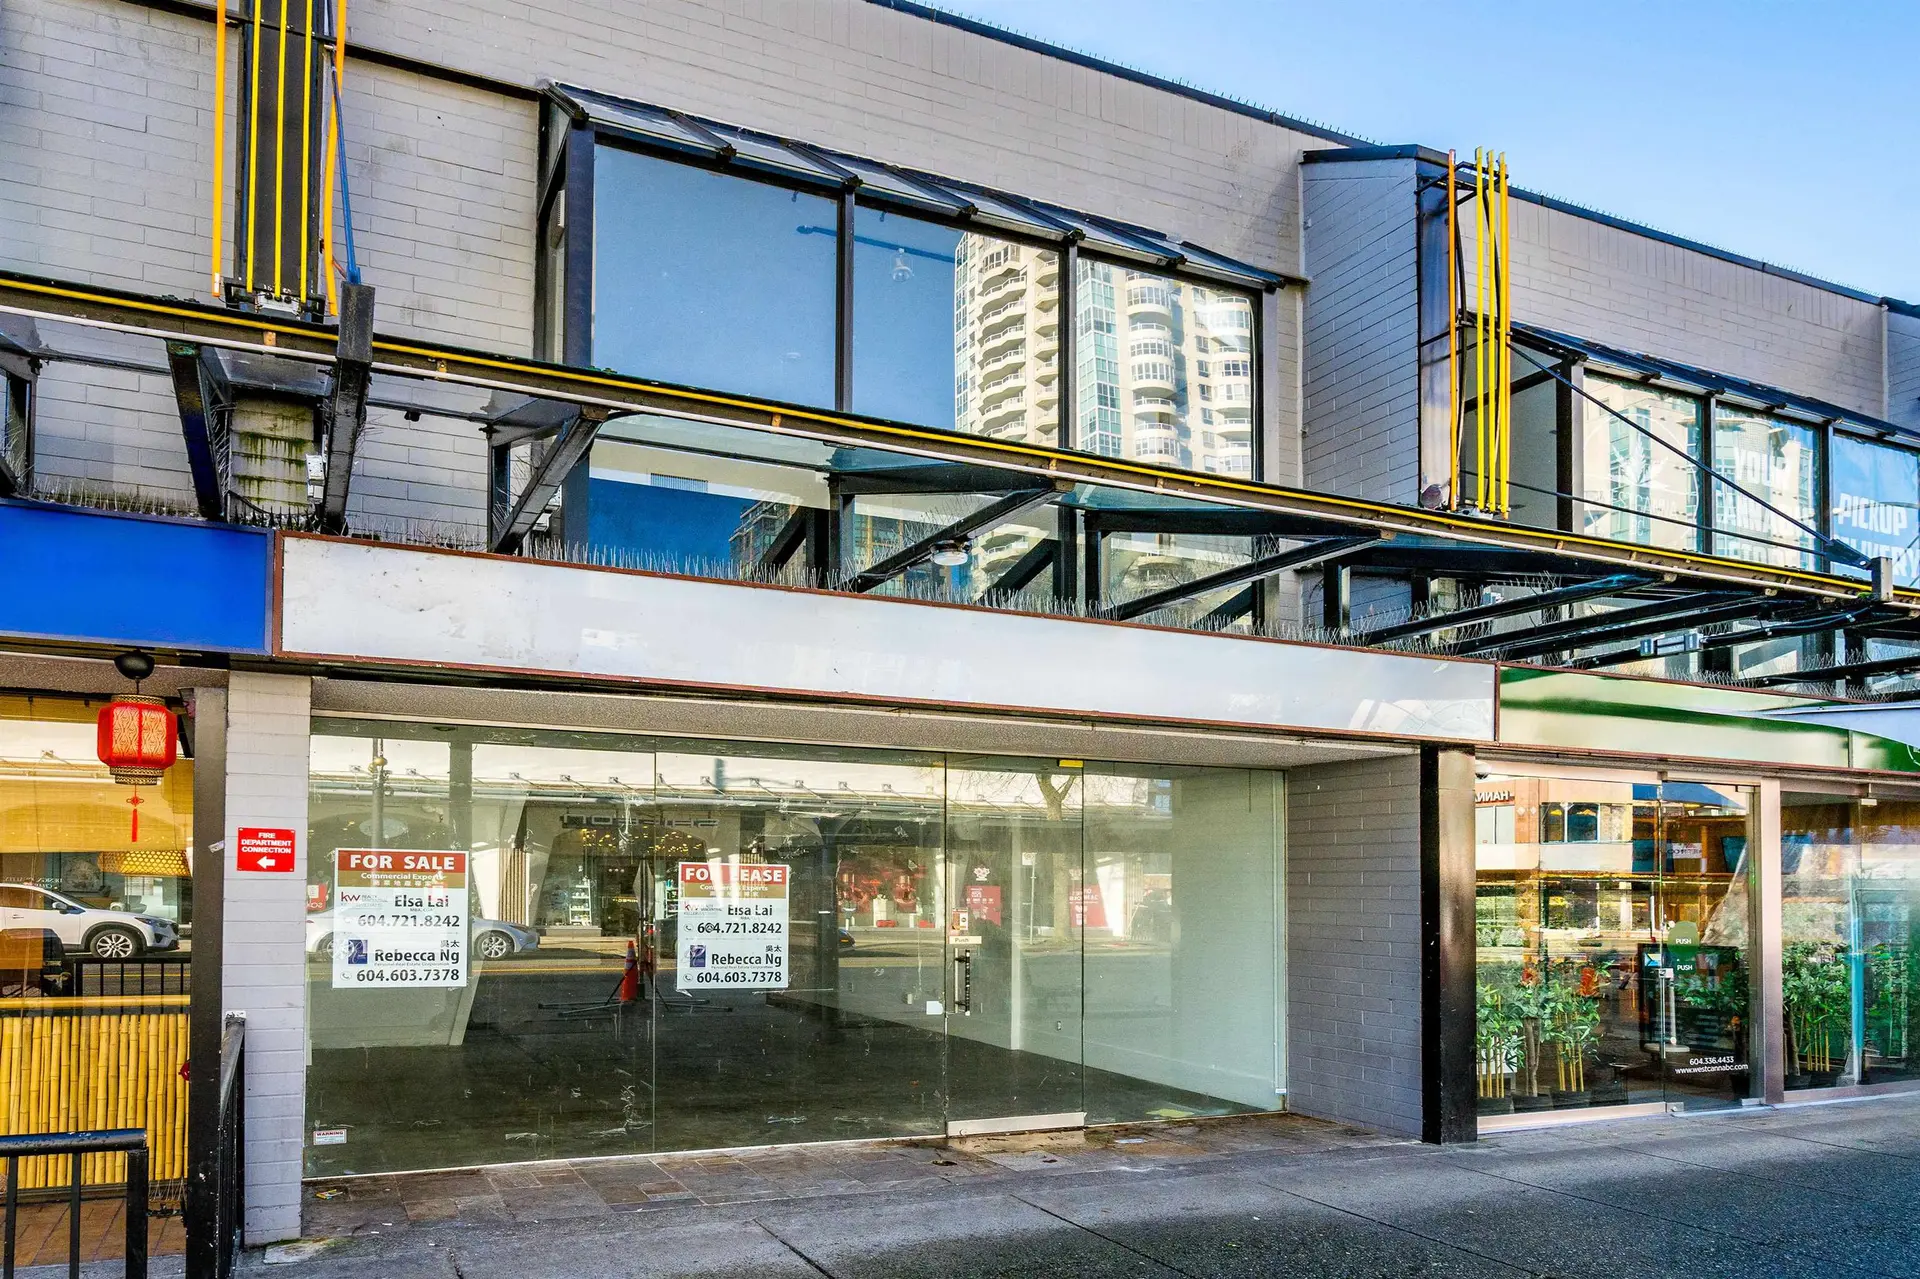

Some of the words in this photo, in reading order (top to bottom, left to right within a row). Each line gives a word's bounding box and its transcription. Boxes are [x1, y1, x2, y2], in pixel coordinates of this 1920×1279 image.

[1837, 492, 1908, 536] PICKUP
[241, 839, 292, 847] DEPARTMENT
[241, 846, 292, 854] CONNECTION
[350, 854, 393, 869] FOR
[403, 856, 455, 870] SALE
[361, 872, 411, 880] Commercial
[685, 867, 716, 881] FO
[738, 868, 783, 882] EASE
[394, 894, 423, 908] Elsa
[428, 895, 449, 908] Lai
[727, 904, 751, 916] Elsa
[755, 904, 773, 916] Lai
[358, 914, 460, 927] 604.721.8242
[697, 922, 782, 934] 604.721.8242
[375, 948, 436, 962] Rebecca
[440, 949, 460, 964] Ng
[711, 953, 762, 965] Rebecca
[765, 953, 782, 967] Ng
[356, 968, 460, 982] 604.603.7378
[696, 971, 782, 983] 604.603.7378
[1689, 1056, 1735, 1065] 604.336.4433
[1674, 1063, 1749, 1074] www.westcannabc.com
